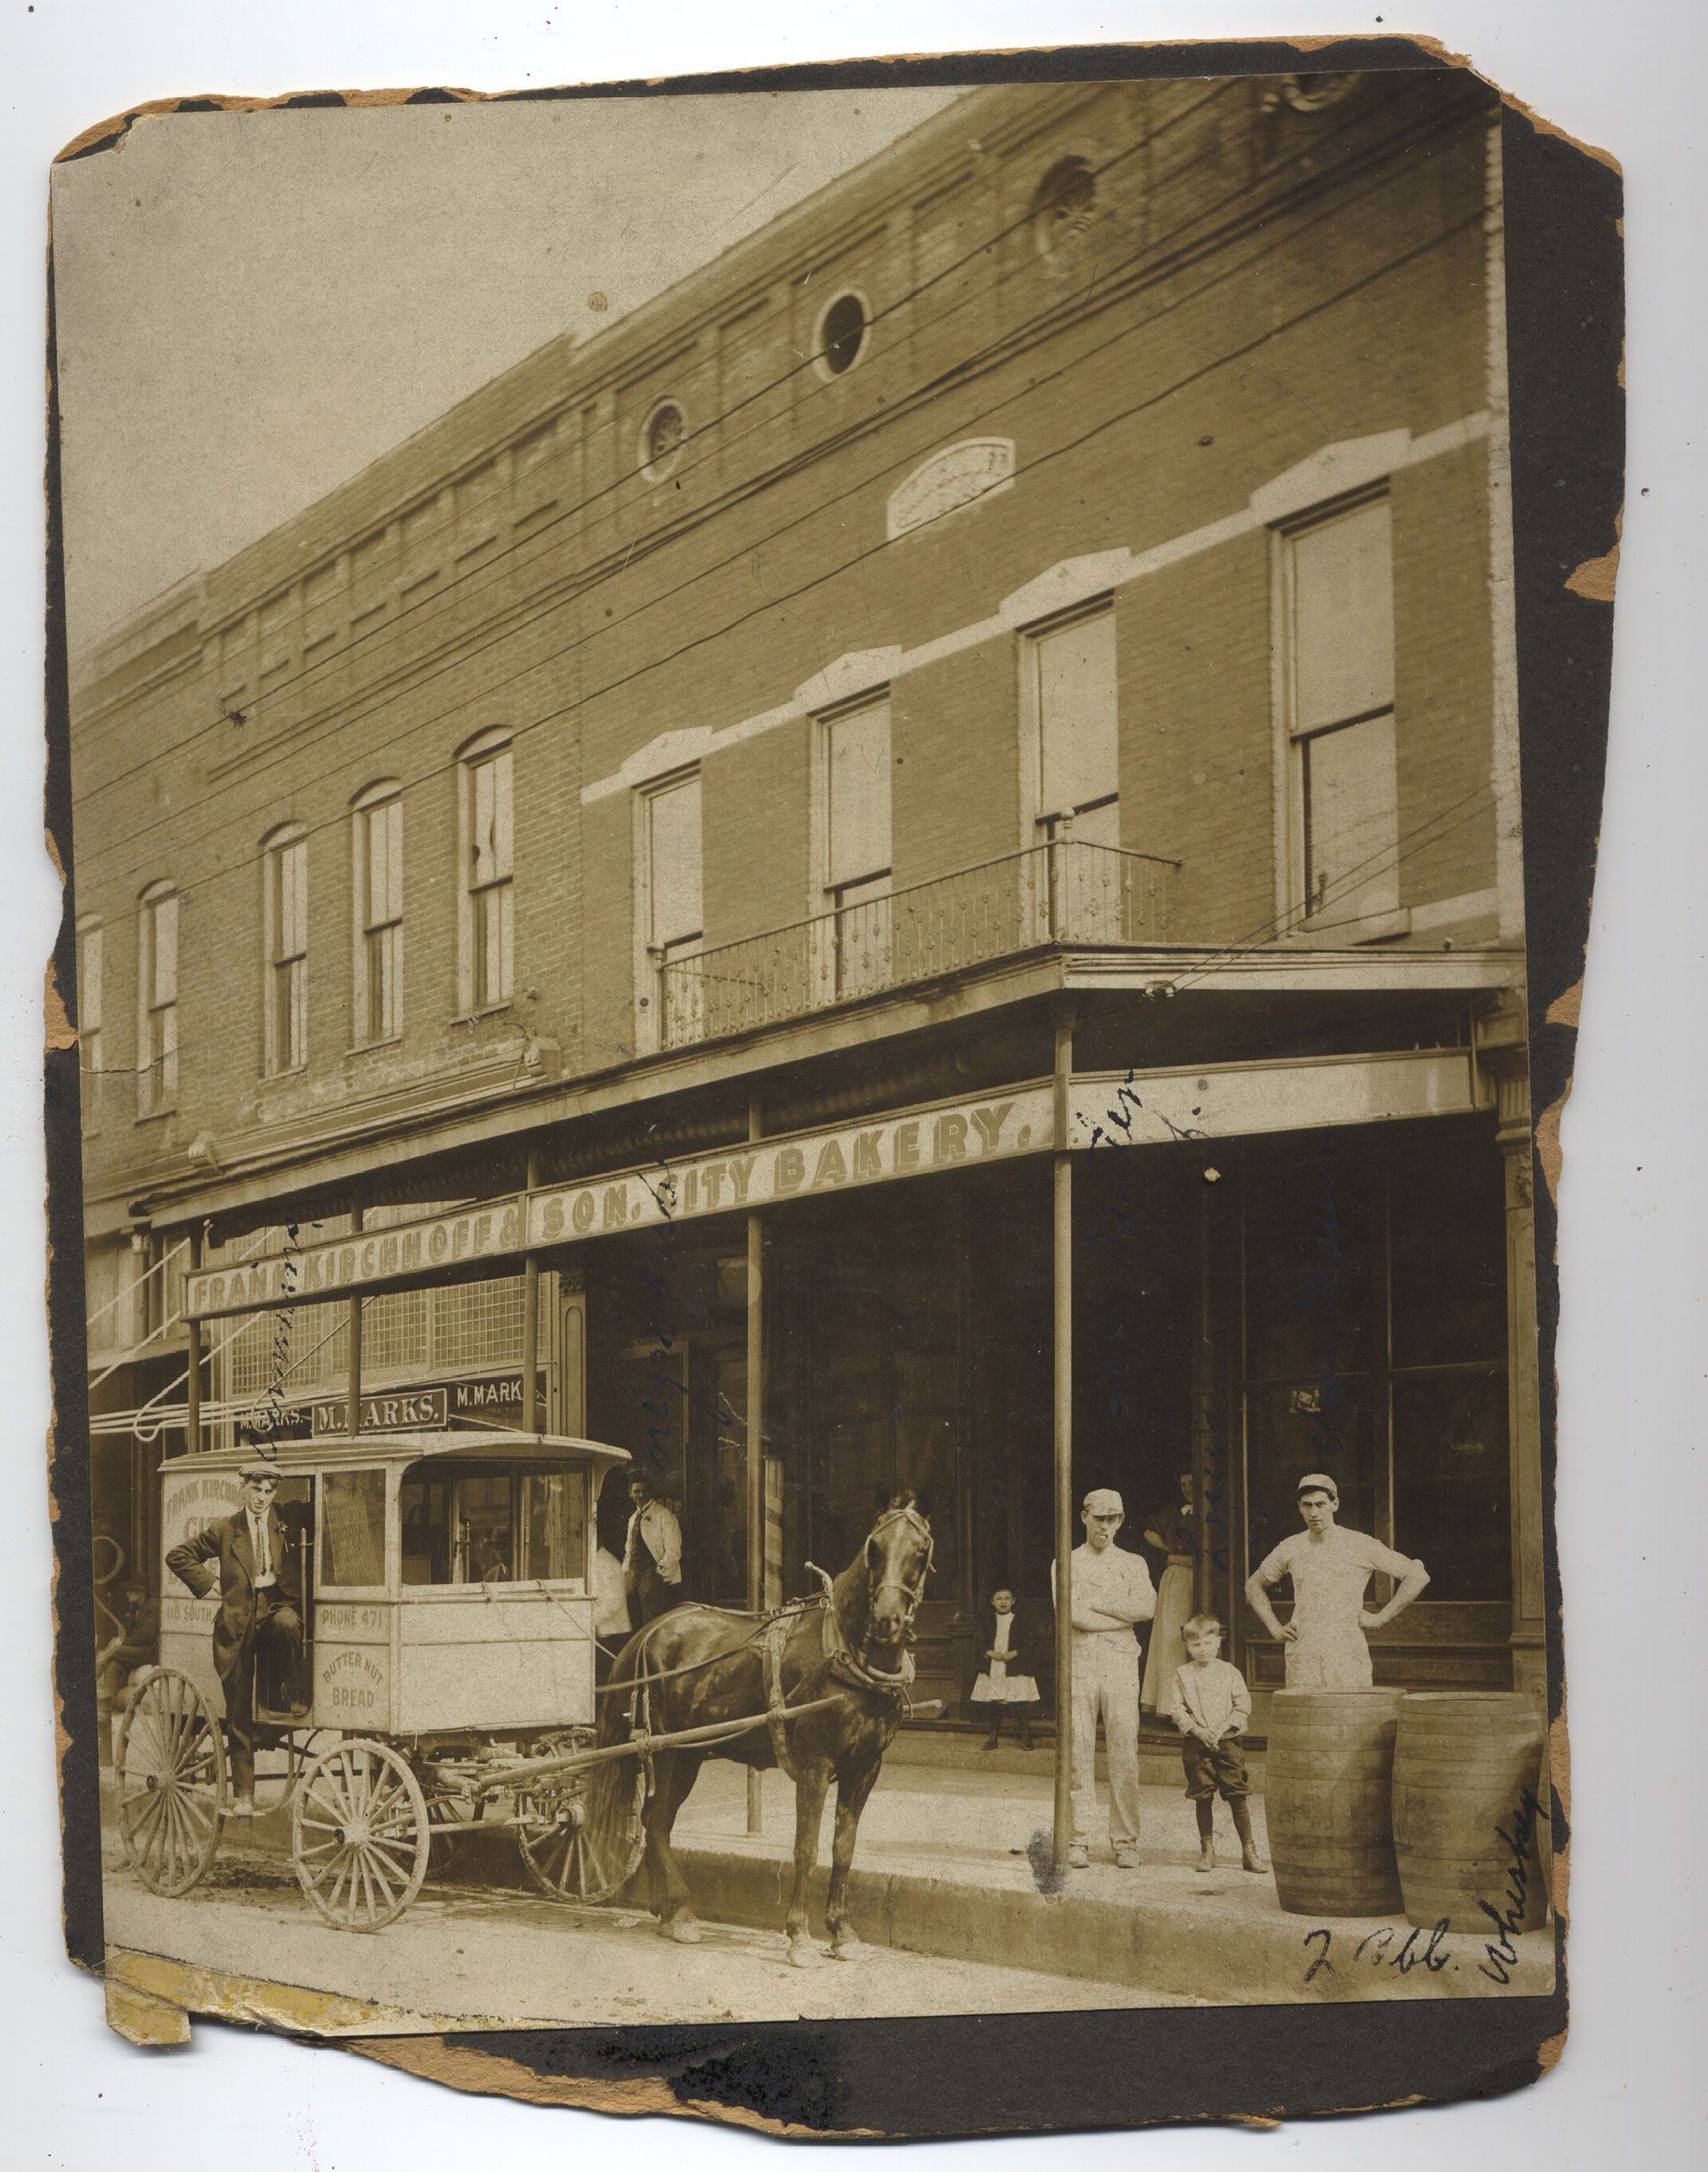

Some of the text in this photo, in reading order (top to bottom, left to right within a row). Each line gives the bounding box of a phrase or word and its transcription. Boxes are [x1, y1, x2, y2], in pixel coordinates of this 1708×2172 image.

[194, 1262, 288, 1312] FRANK
[303, 1215, 491, 1288] KIRCHHOFF
[657, 1156, 756, 1216] CITY
[773, 1102, 1032, 1195] BAKERY.
[166, 1480, 199, 1523] FRANK
[183, 1605, 212, 1622] SOUTH
[322, 1609, 383, 1627] PHONE 471
[323, 1652, 383, 1685] BUTTER NUT
[333, 1687, 374, 1708] BREAD
